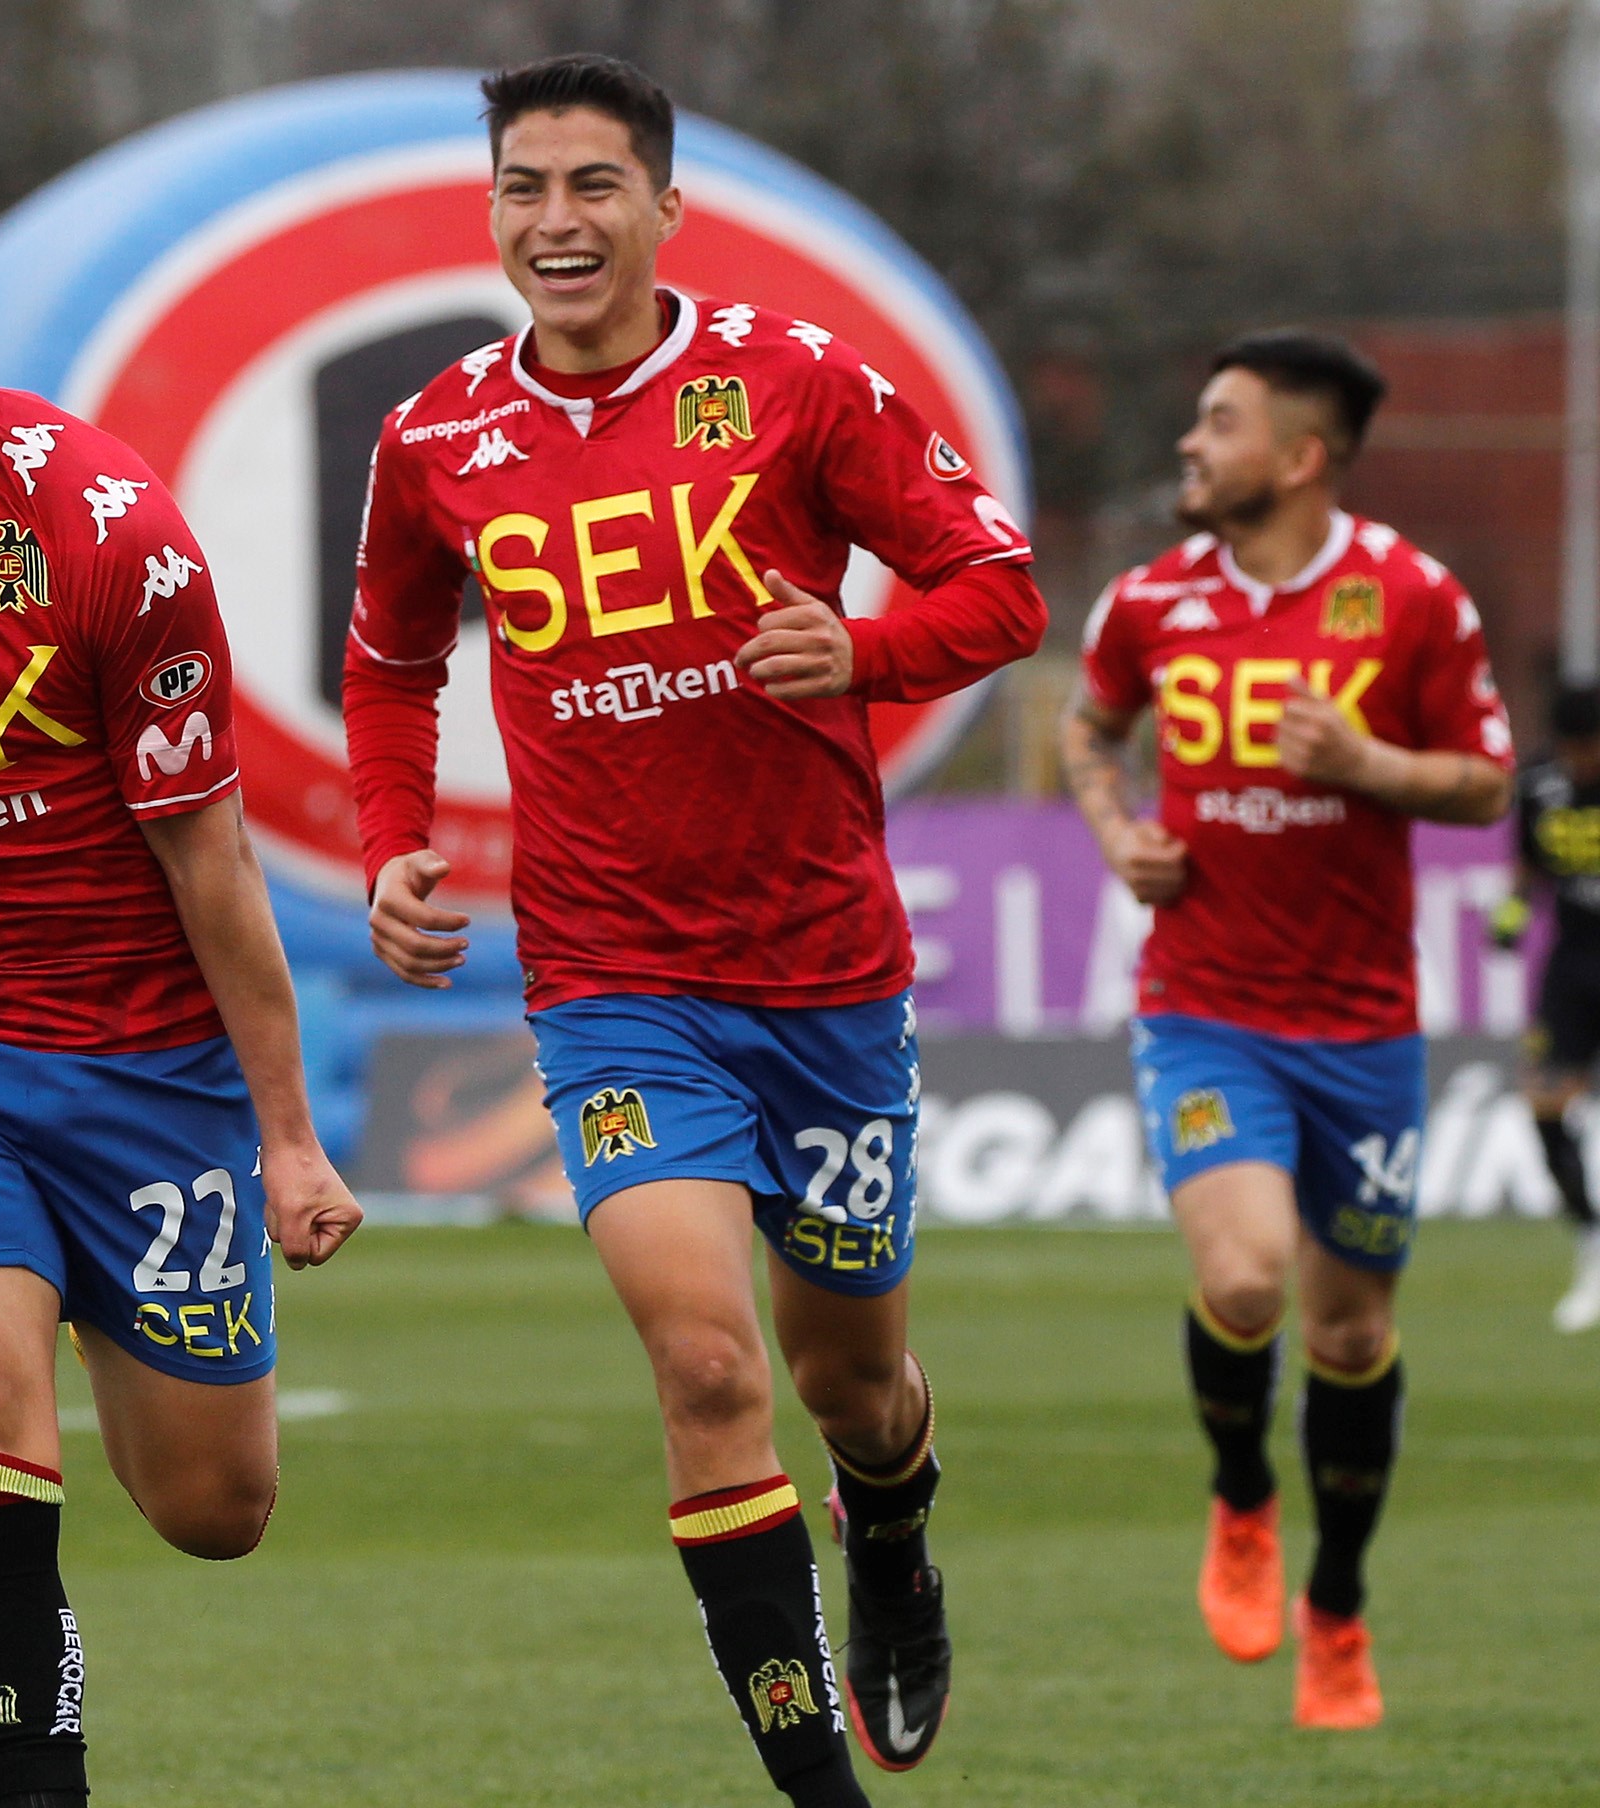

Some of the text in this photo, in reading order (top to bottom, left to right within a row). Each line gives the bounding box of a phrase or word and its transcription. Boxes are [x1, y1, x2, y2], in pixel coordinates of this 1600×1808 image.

[477, 473, 775, 653] SEK
[158, 661, 196, 699] PF
[550, 657, 740, 722] starken
[1160, 654, 1384, 768] SEK
[793, 1118, 895, 1224] 28
[128, 1167, 247, 1293] 22
[791, 1214, 897, 1271] SEK
[49, 1607, 85, 1736] IBEROCAR
[810, 1563, 847, 1733] OCAR
